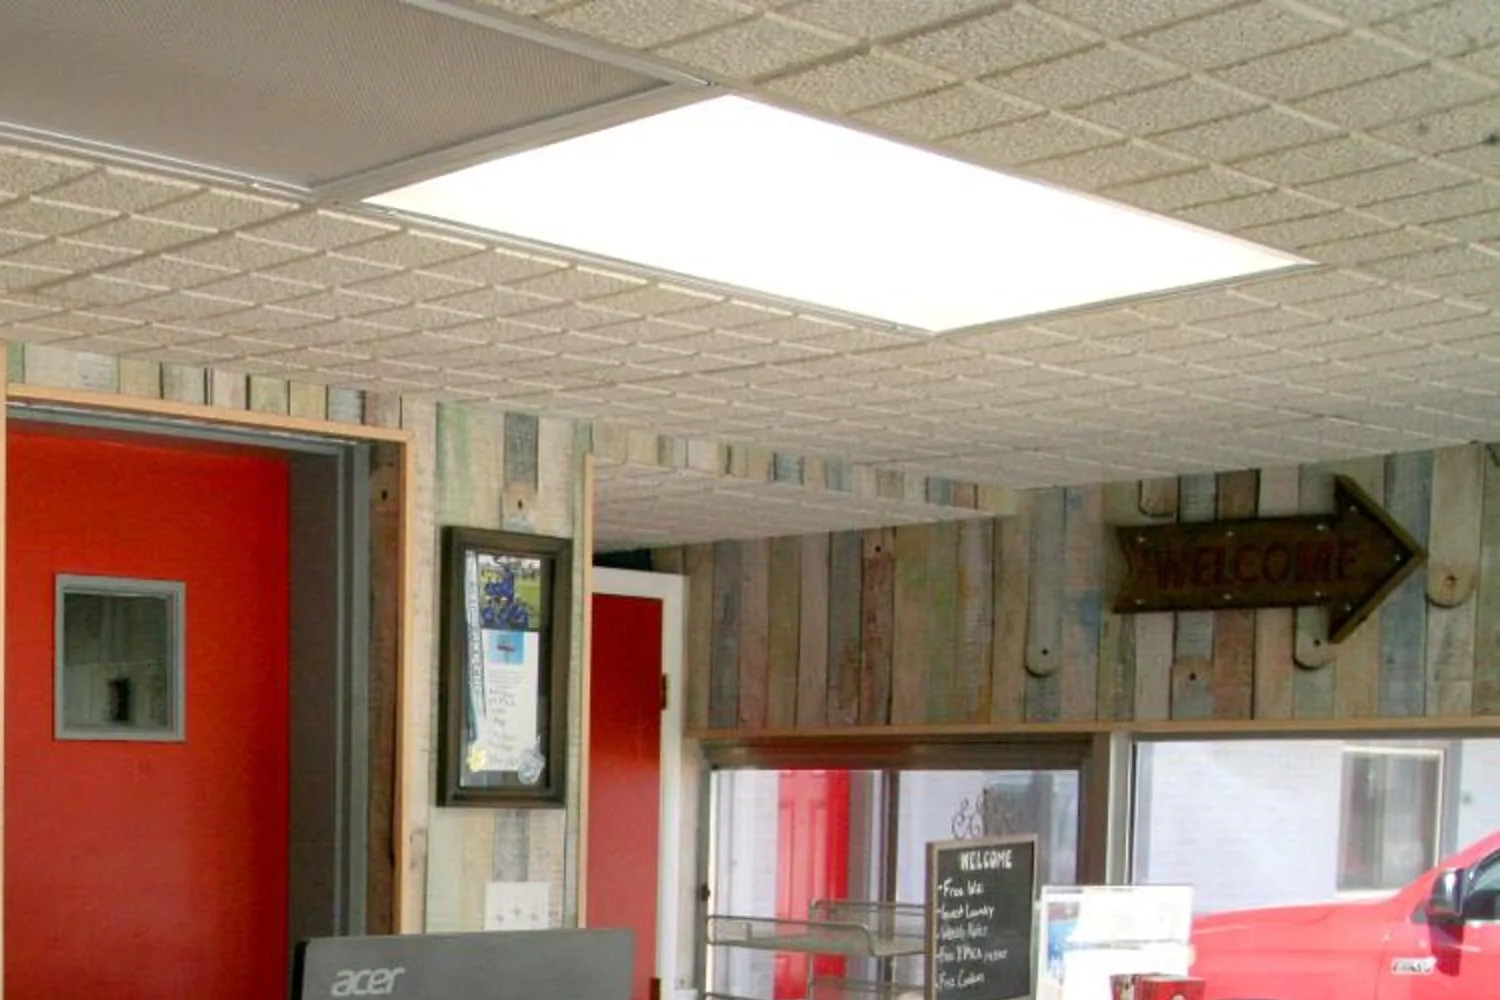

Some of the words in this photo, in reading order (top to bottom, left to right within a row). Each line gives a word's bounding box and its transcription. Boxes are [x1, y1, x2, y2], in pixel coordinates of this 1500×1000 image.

[1154, 538, 1362, 591] WELCOME
[960, 849, 1012, 871] WELCOME
[331, 966, 406, 998] acer
